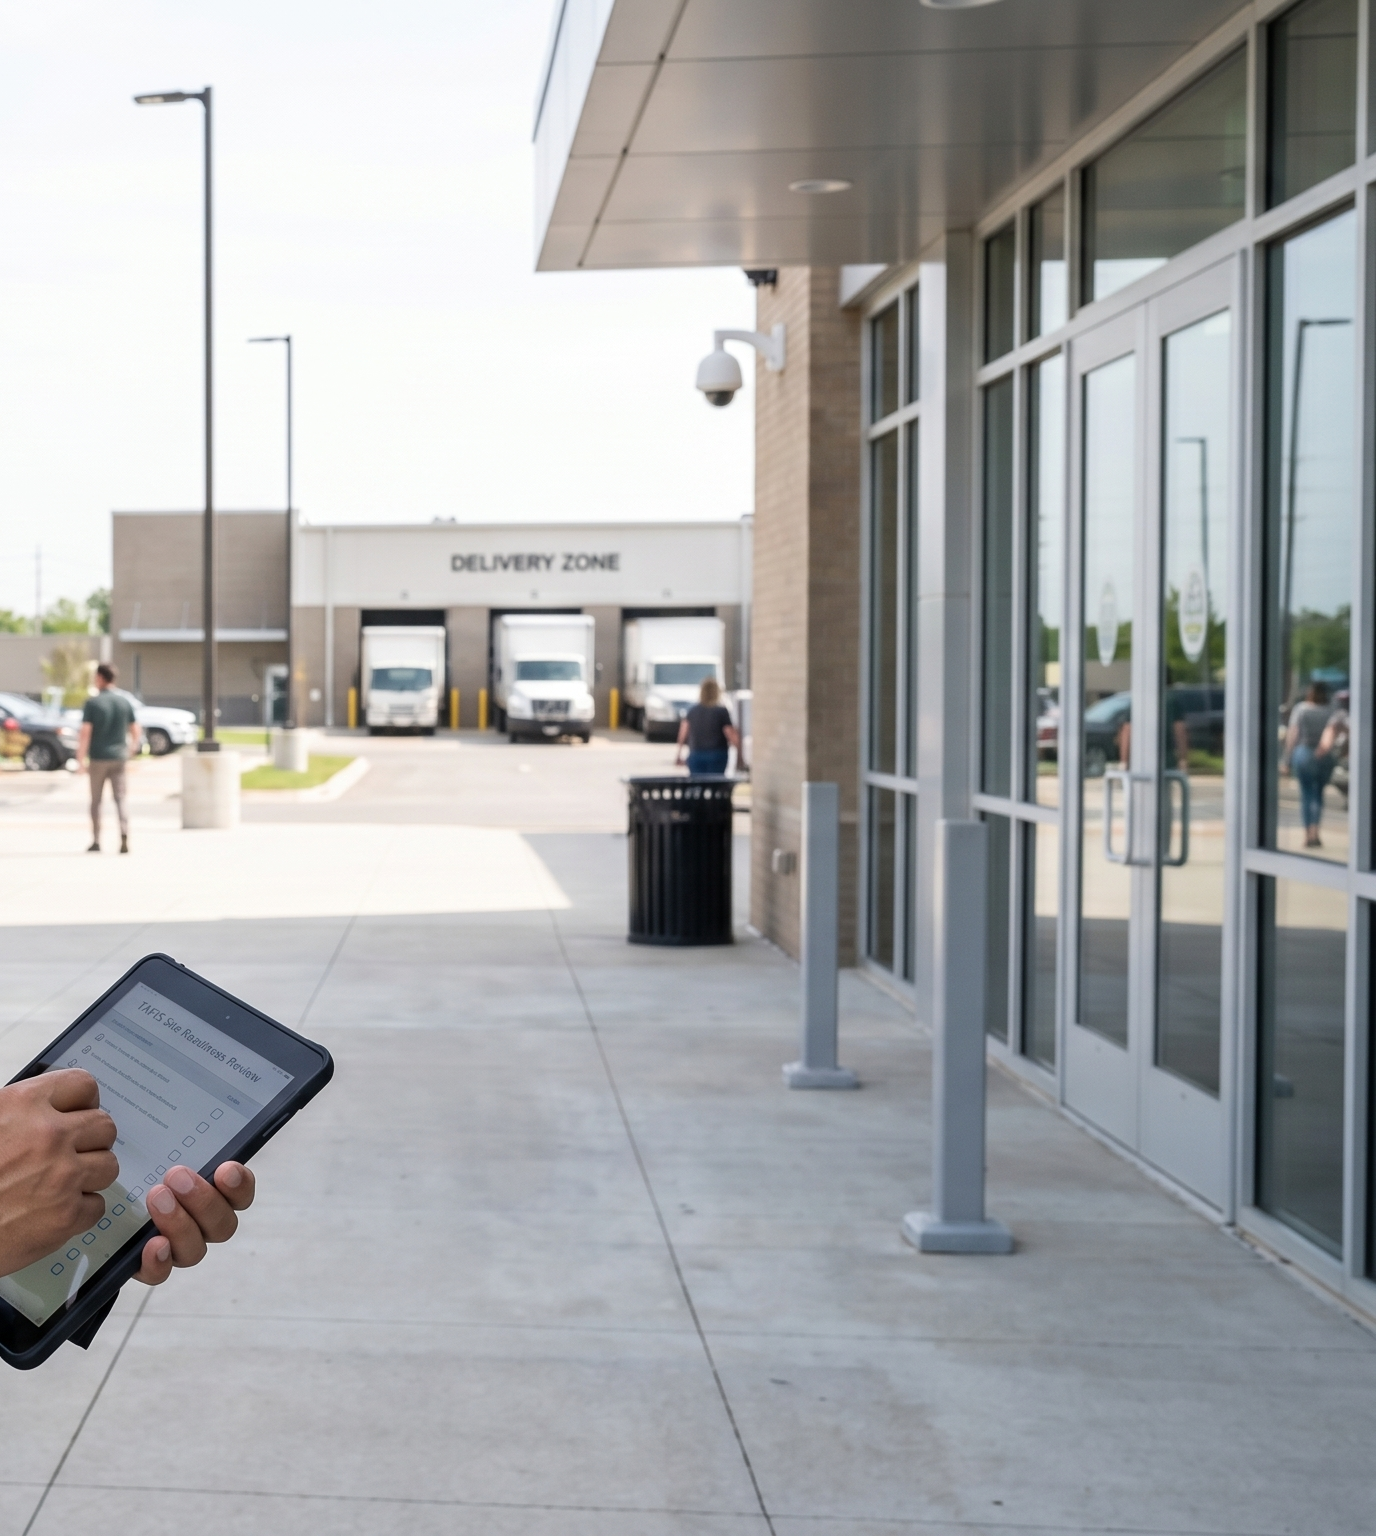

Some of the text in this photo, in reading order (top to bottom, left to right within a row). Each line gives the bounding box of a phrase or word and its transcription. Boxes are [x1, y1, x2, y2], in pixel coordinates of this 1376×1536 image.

[452, 554, 619, 571] DELIVERY ZONE
[137, 1001, 166, 1022] TAFIS
